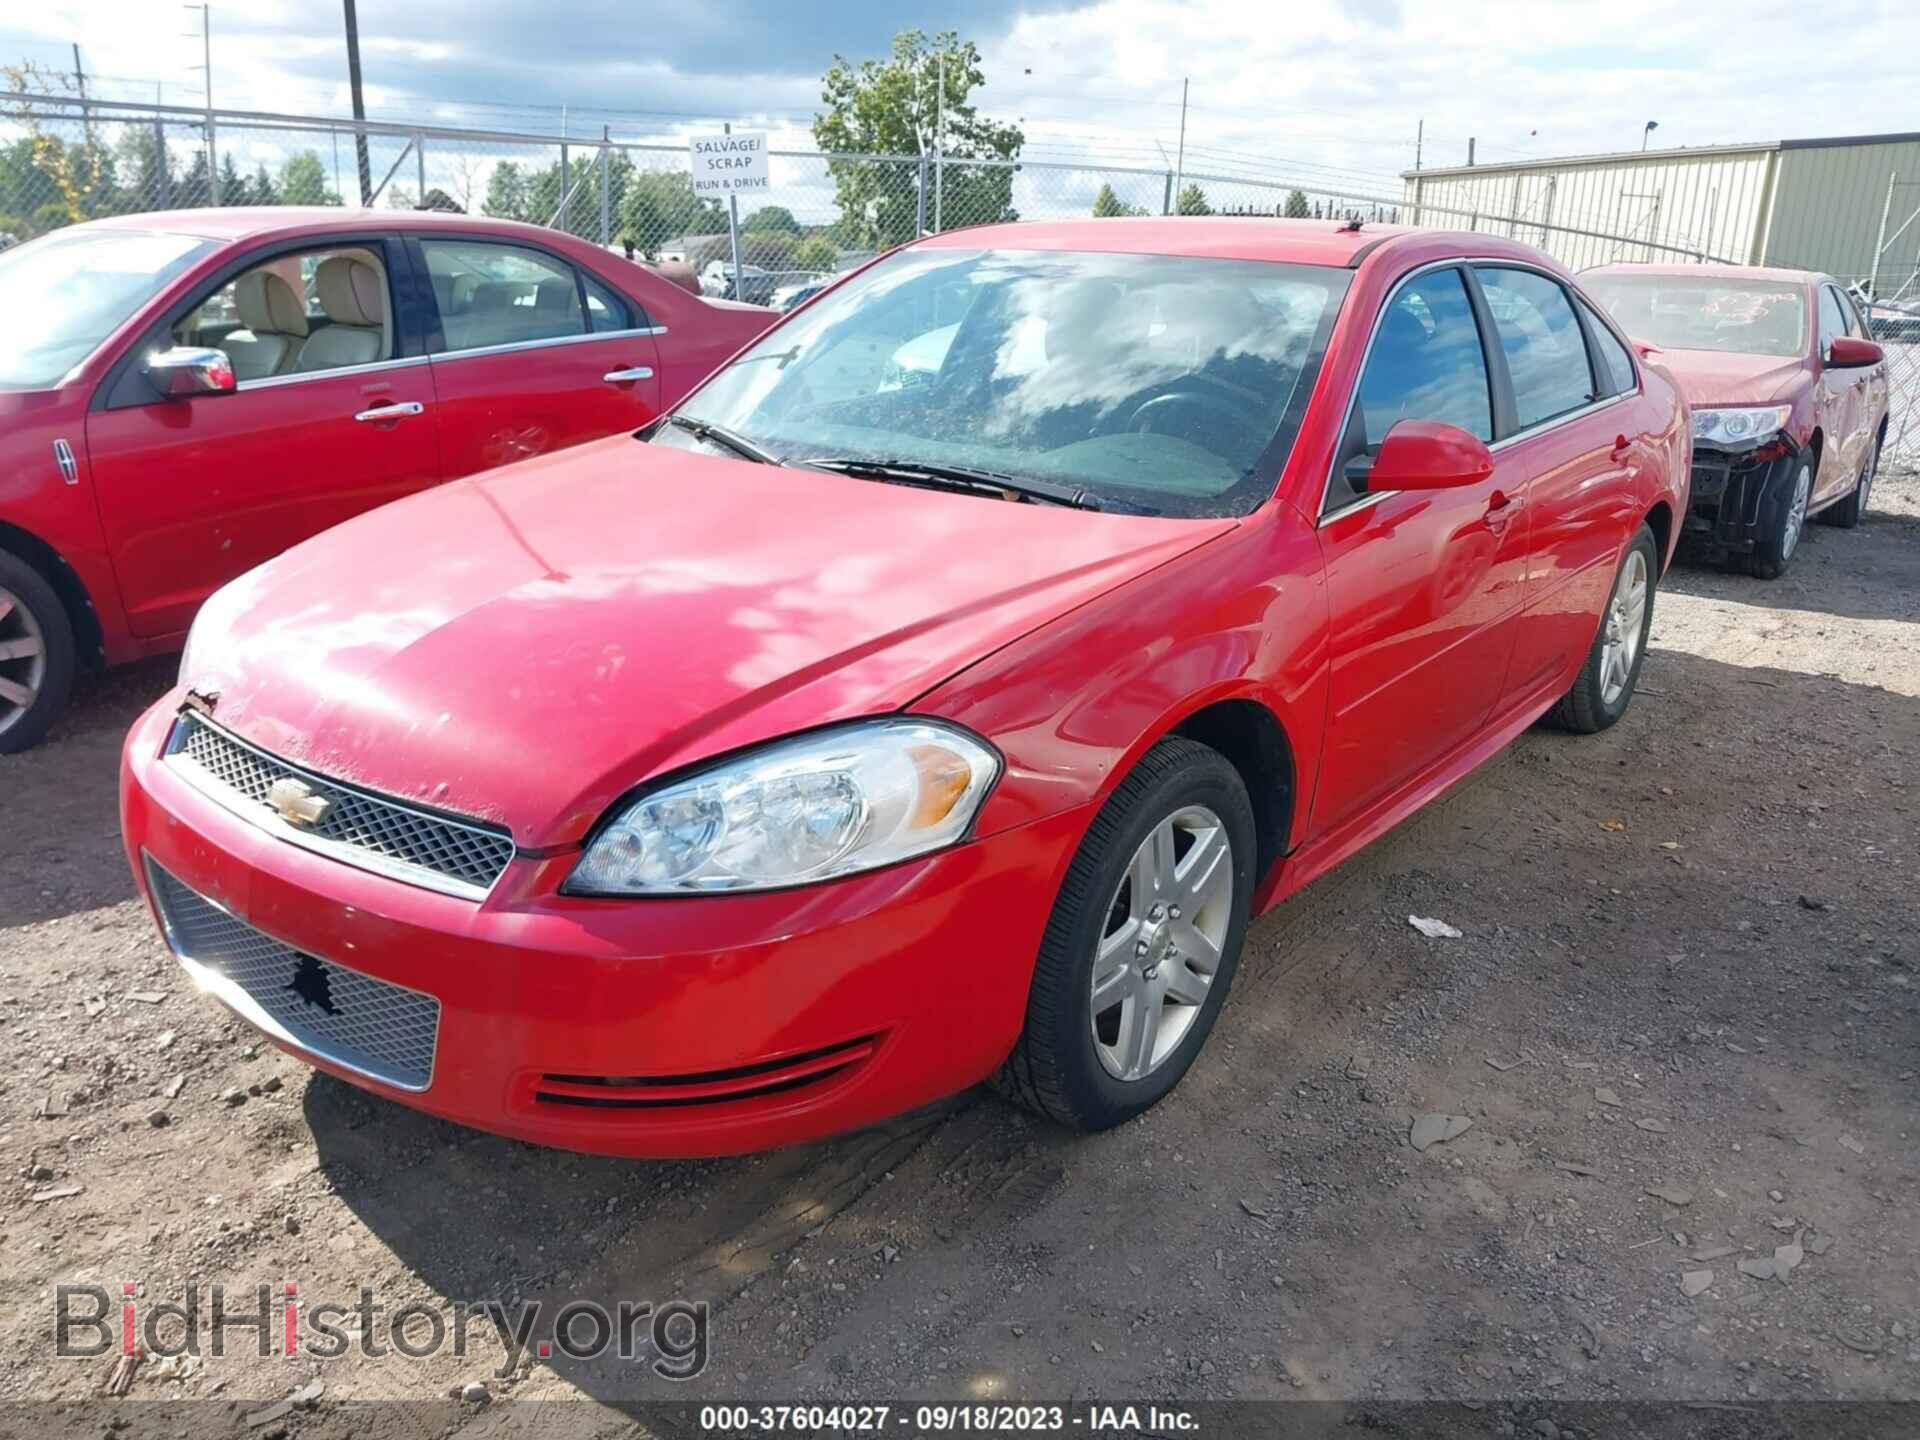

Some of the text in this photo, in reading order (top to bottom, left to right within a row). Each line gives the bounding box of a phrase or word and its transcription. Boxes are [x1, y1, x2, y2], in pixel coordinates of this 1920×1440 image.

[695, 139, 761, 153] SALVAGE/
[707, 156, 752, 170] SCRAP
[695, 176, 768, 190] RUN & DRIVE
